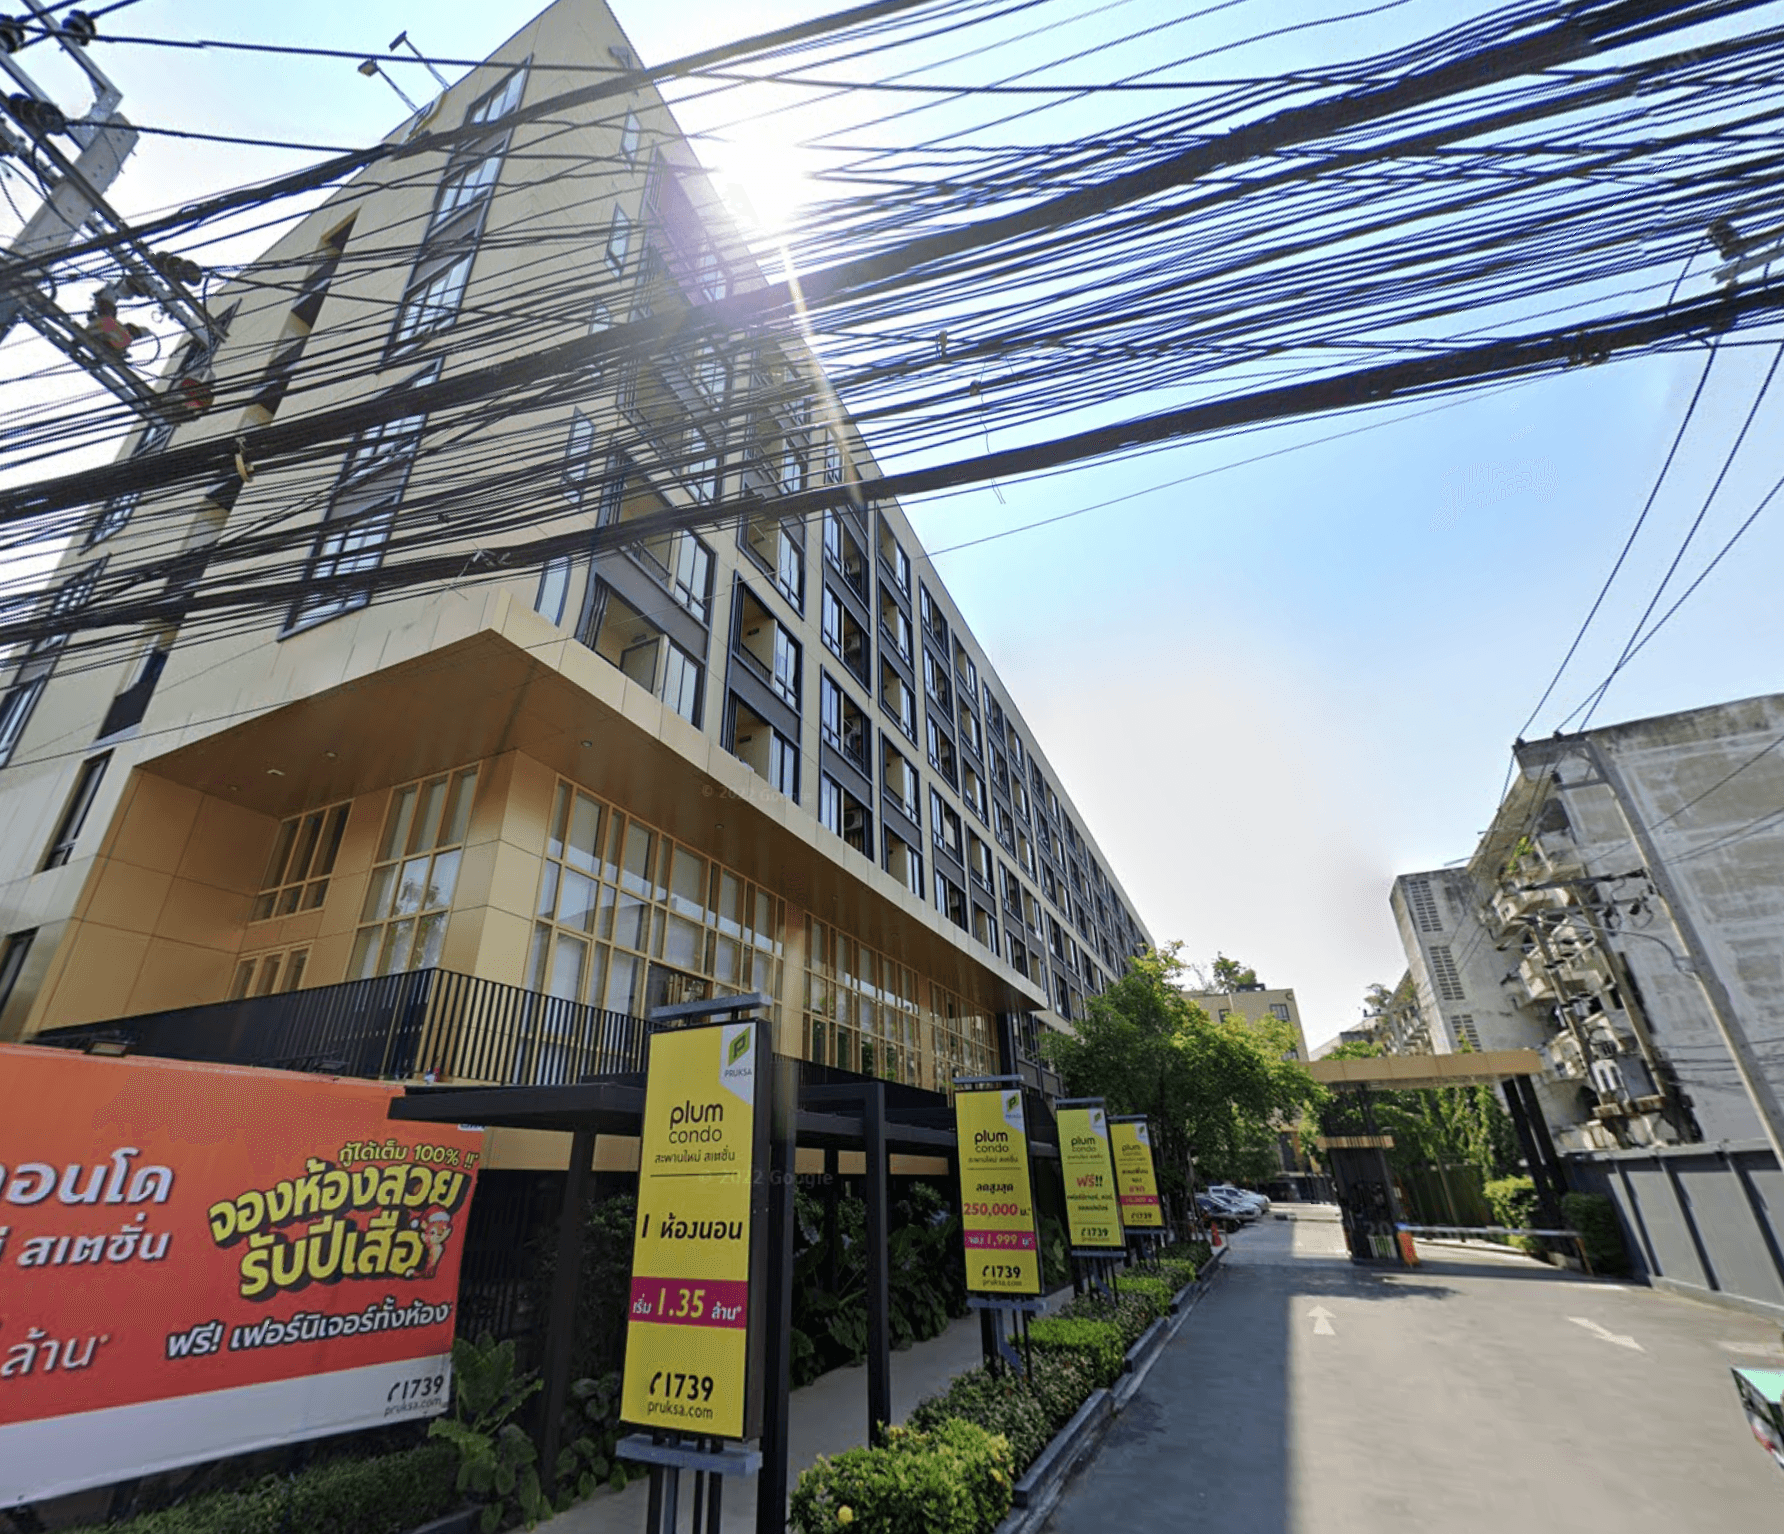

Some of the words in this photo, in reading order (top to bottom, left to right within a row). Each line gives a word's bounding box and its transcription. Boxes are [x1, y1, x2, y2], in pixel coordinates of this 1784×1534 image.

[724, 1068, 752, 1078] PRUKSA
[669, 1100, 724, 1130] plum
[669, 1126, 723, 1144] condo
[974, 1130, 1009, 1145] plum
[1071, 1136, 1096, 1146] plum
[339, 1139, 408, 1166] กู้ได้เต็ม
[415, 1144, 460, 1166] 100%
[975, 1143, 1009, 1153] condo
[208, 1157, 467, 1246] จองห้องสวย
[963, 1202, 1018, 1217] 250,000
[660, 1212, 743, 1240] ห้องนอน
[16, 1211, 171, 1267] สเตชั่น
[239, 1209, 425, 1298] รับปีเสือ
[991, 1265, 1022, 1278] 1739
[632, 1292, 652, 1314] เริ่ม
[657, 1287, 706, 1318] 1.35
[167, 1322, 224, 1358] ฟรี!
[402, 1375, 444, 1399] 1739
[664, 1372, 714, 1402] 1739
[384, 1397, 442, 1417] pruksa.com
[647, 1399, 714, 1419] pruksa.com
